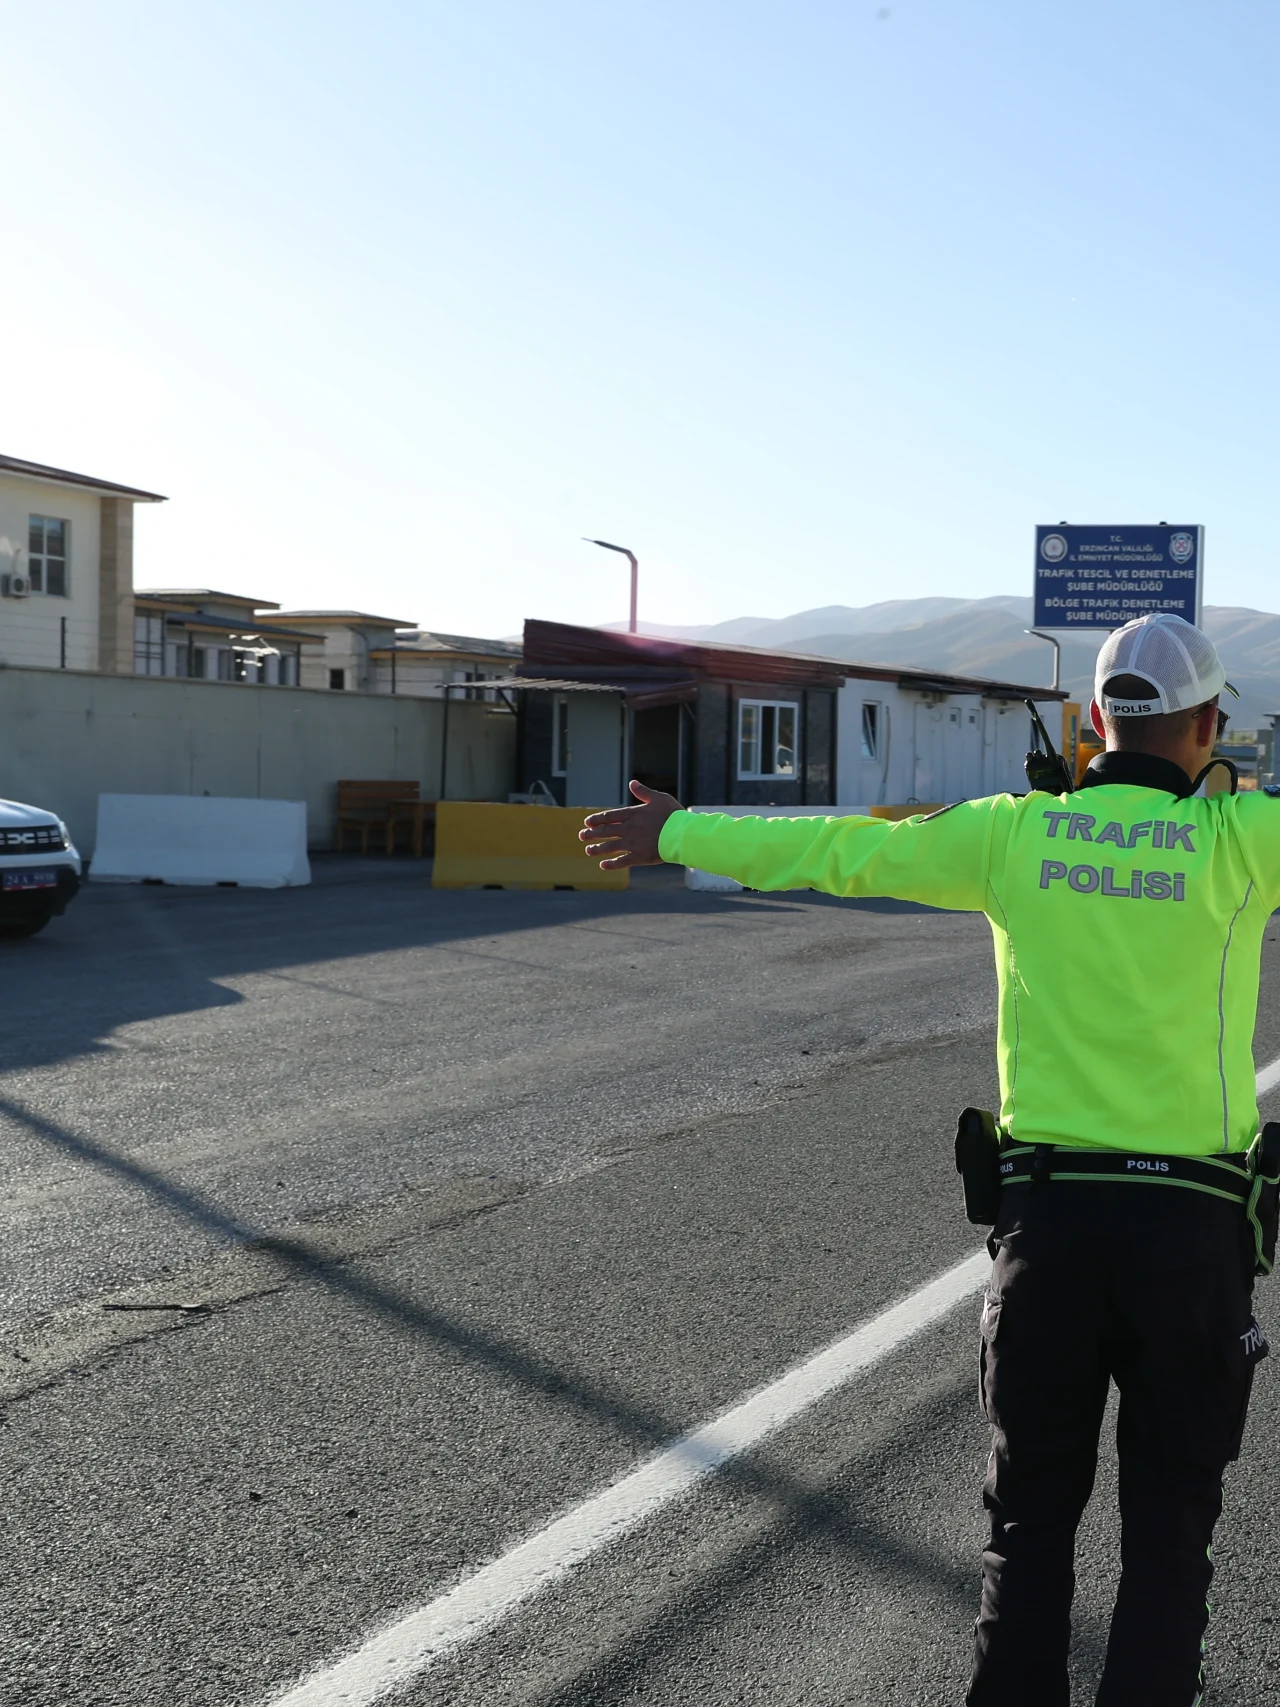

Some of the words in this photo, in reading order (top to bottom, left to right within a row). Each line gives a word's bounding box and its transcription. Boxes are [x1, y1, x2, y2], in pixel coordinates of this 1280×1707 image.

[1115, 569, 1130, 579] VE
[1131, 569, 1195, 579] DENETLEME
[1067, 582, 1095, 592] ŞUBE
[1096, 580, 1163, 591] MÜDÜRLÜĞÜ
[1045, 597, 1079, 608] BÖLGE
[1122, 599, 1185, 609] DENETLEME
[1066, 611, 1094, 621] ŞUBE
[1113, 704, 1152, 713] POLİS
[1127, 1160, 1170, 1171] POLİS
